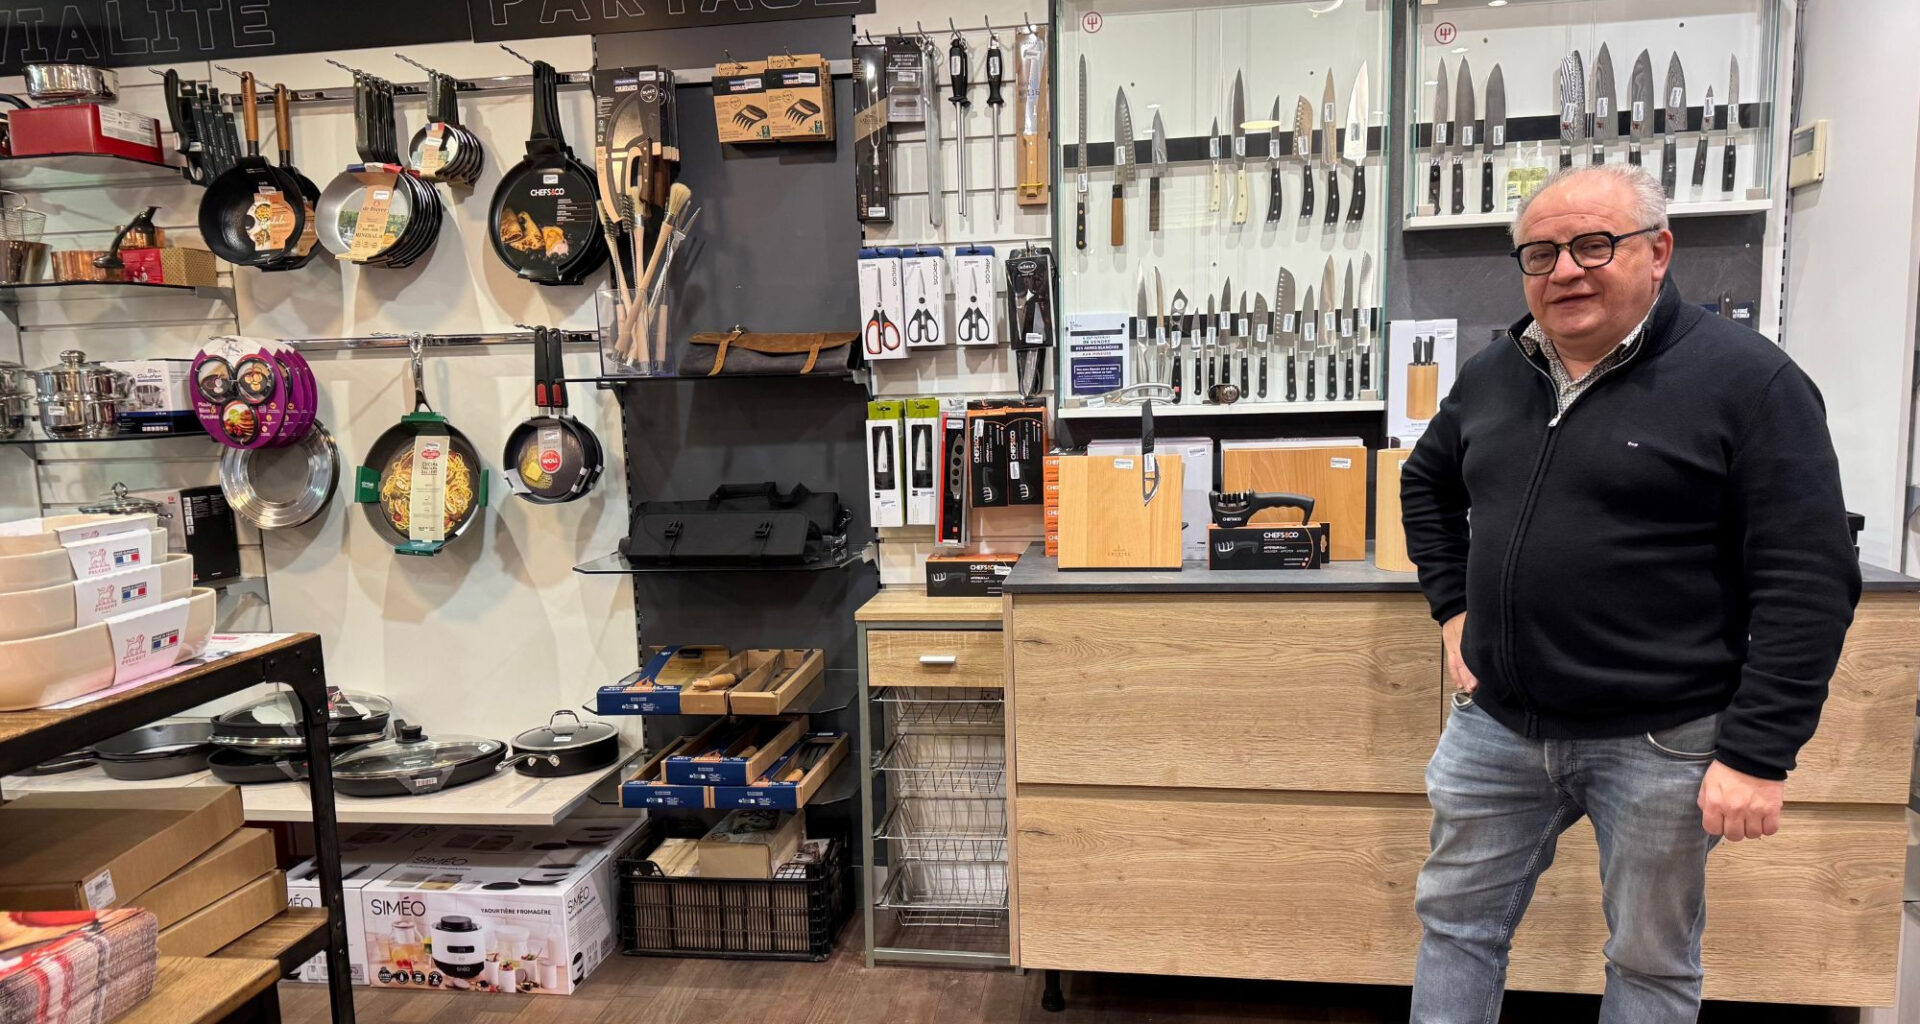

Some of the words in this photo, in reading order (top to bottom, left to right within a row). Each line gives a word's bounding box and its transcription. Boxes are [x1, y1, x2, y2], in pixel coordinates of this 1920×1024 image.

[530, 188, 565, 196] CHEFS&CO
[1263, 531, 1299, 539] CHEFS&CO
[371, 896, 426, 917] SIMÉO
[481, 907, 515, 915] YAOURTIÈRE
[516, 908, 552, 916] FROMAGÈRE
